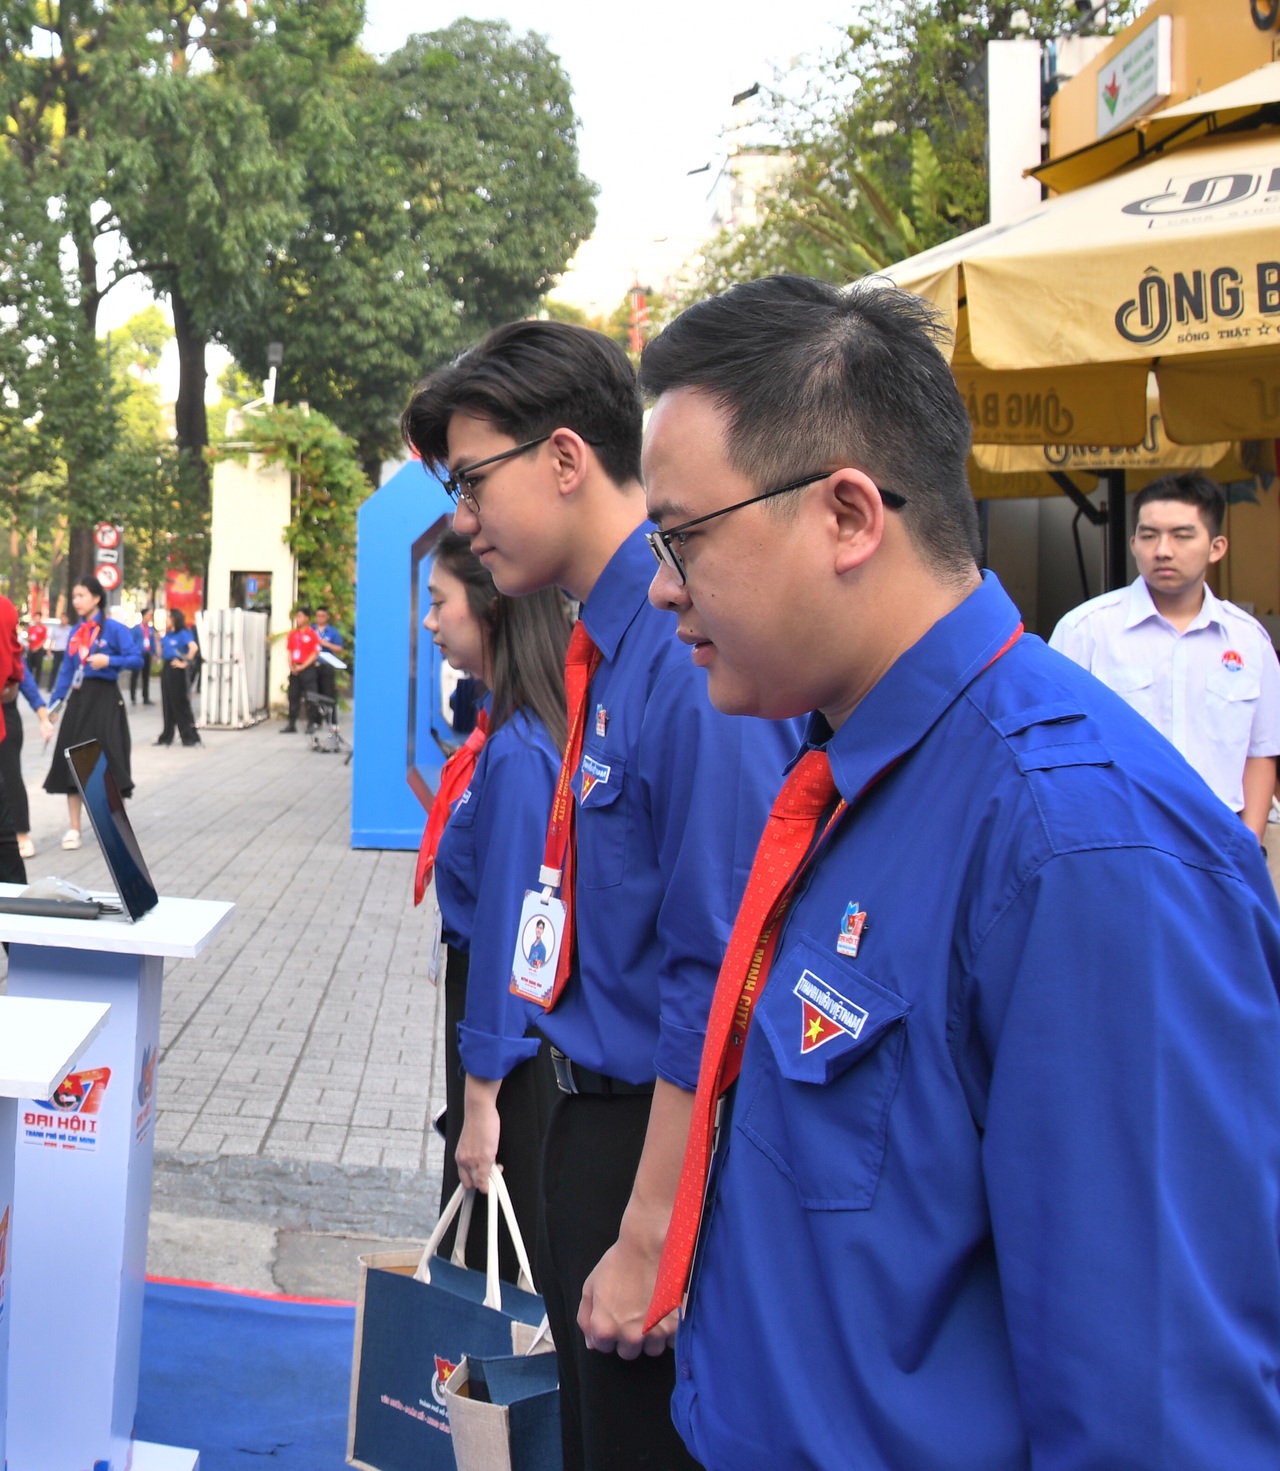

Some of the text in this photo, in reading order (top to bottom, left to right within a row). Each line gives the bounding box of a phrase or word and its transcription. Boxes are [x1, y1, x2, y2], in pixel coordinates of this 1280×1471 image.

[1115, 265, 1244, 345] ÔNG
[1177, 327, 1251, 343] SỐNG THẬT
[744, 949, 765, 991] MINH
[734, 994, 752, 1030] CITY
[24, 1112, 97, 1133] ĐẠI HỘI I
